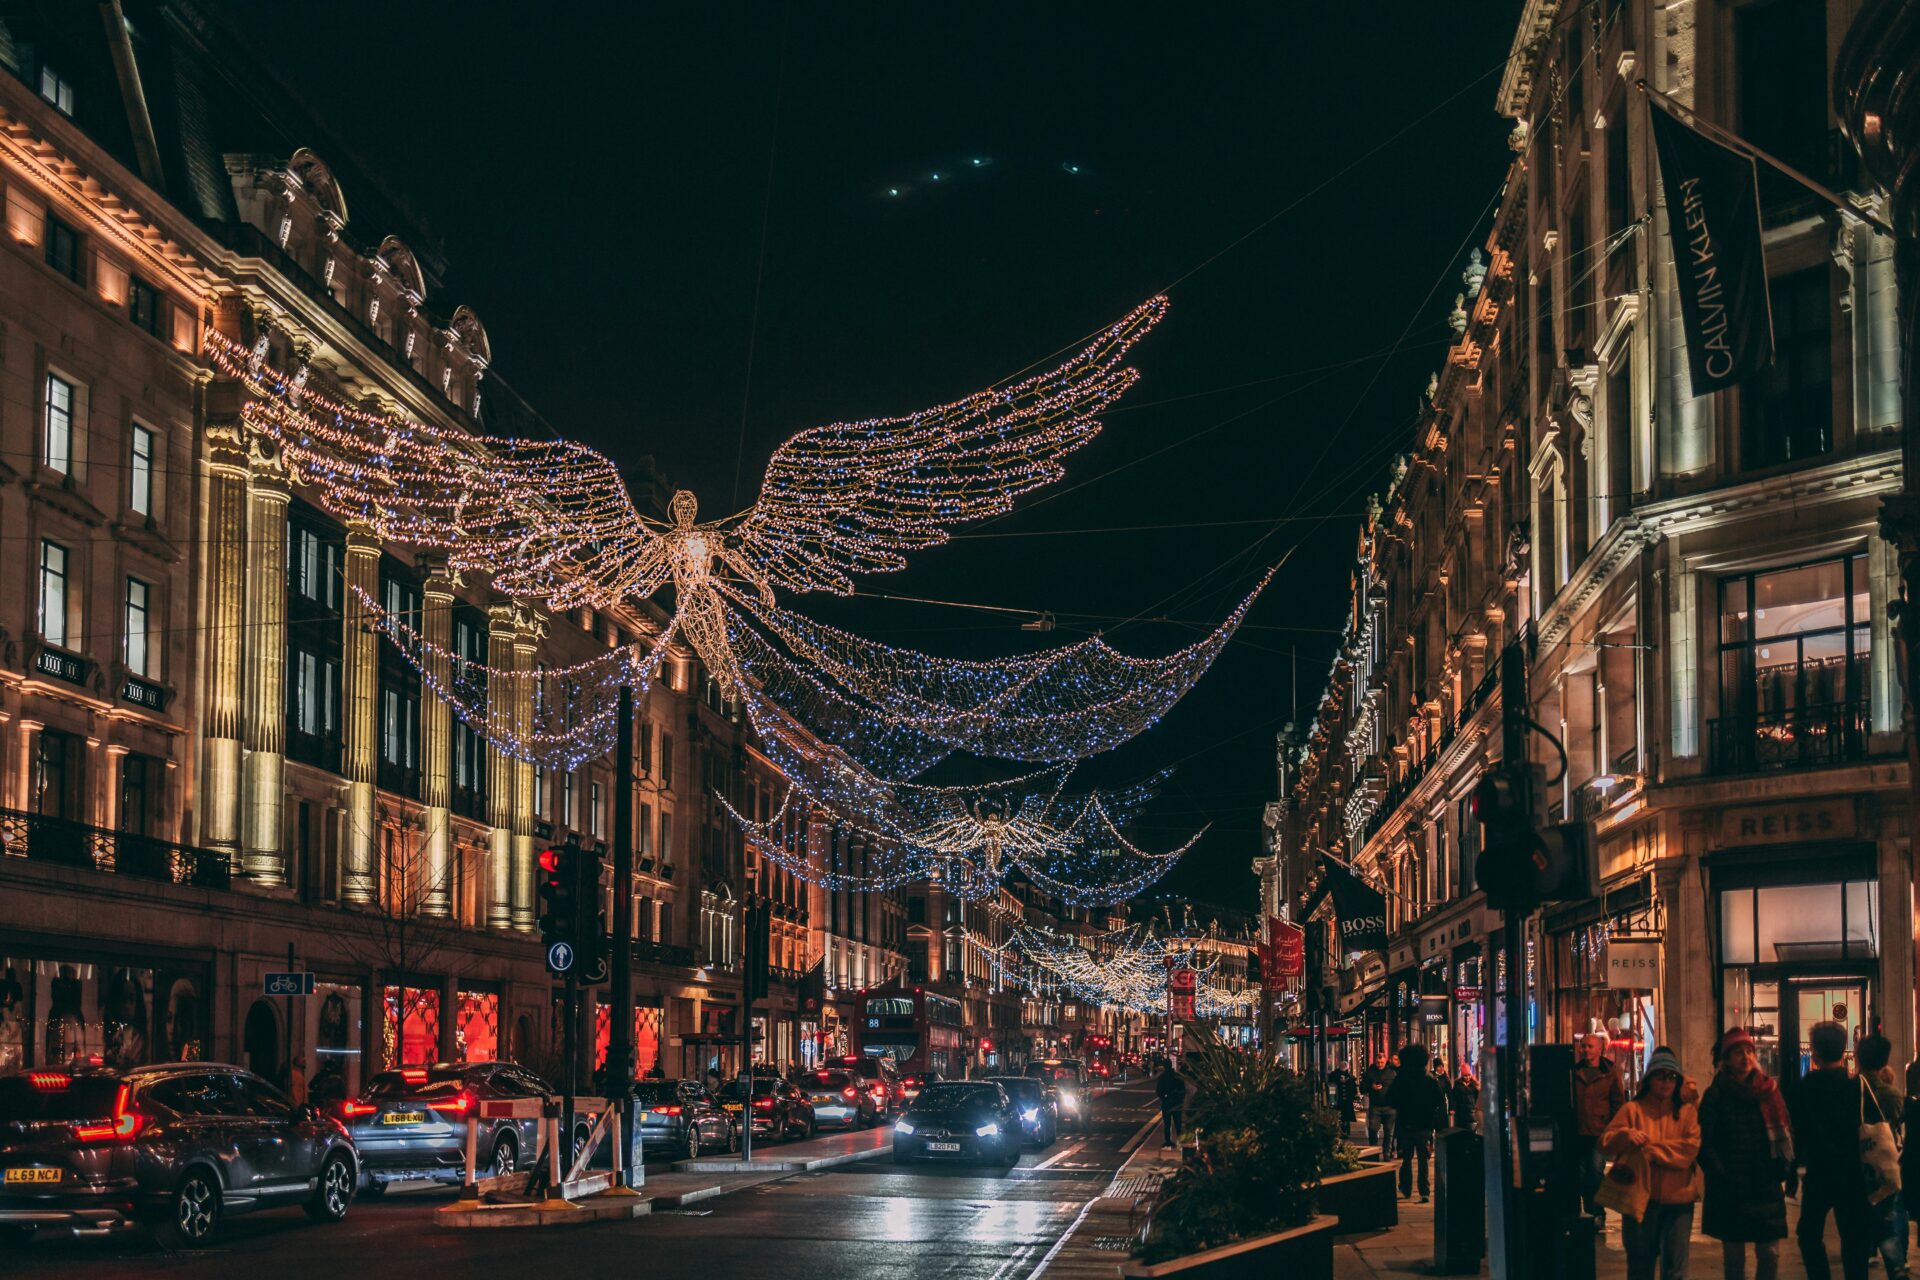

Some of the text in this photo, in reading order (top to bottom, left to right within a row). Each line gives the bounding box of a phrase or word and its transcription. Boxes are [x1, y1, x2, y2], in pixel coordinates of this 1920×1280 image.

[1679, 177, 1733, 378] CALVIN KLEIN
[1741, 811, 1832, 836] REISS
[1341, 915, 1385, 934] BOSS
[1611, 959, 1656, 968] REISS
[868, 1018, 880, 1028] 88
[384, 1112, 424, 1122] LT68 LXU
[6, 1170, 59, 1181] LL69 NCA
